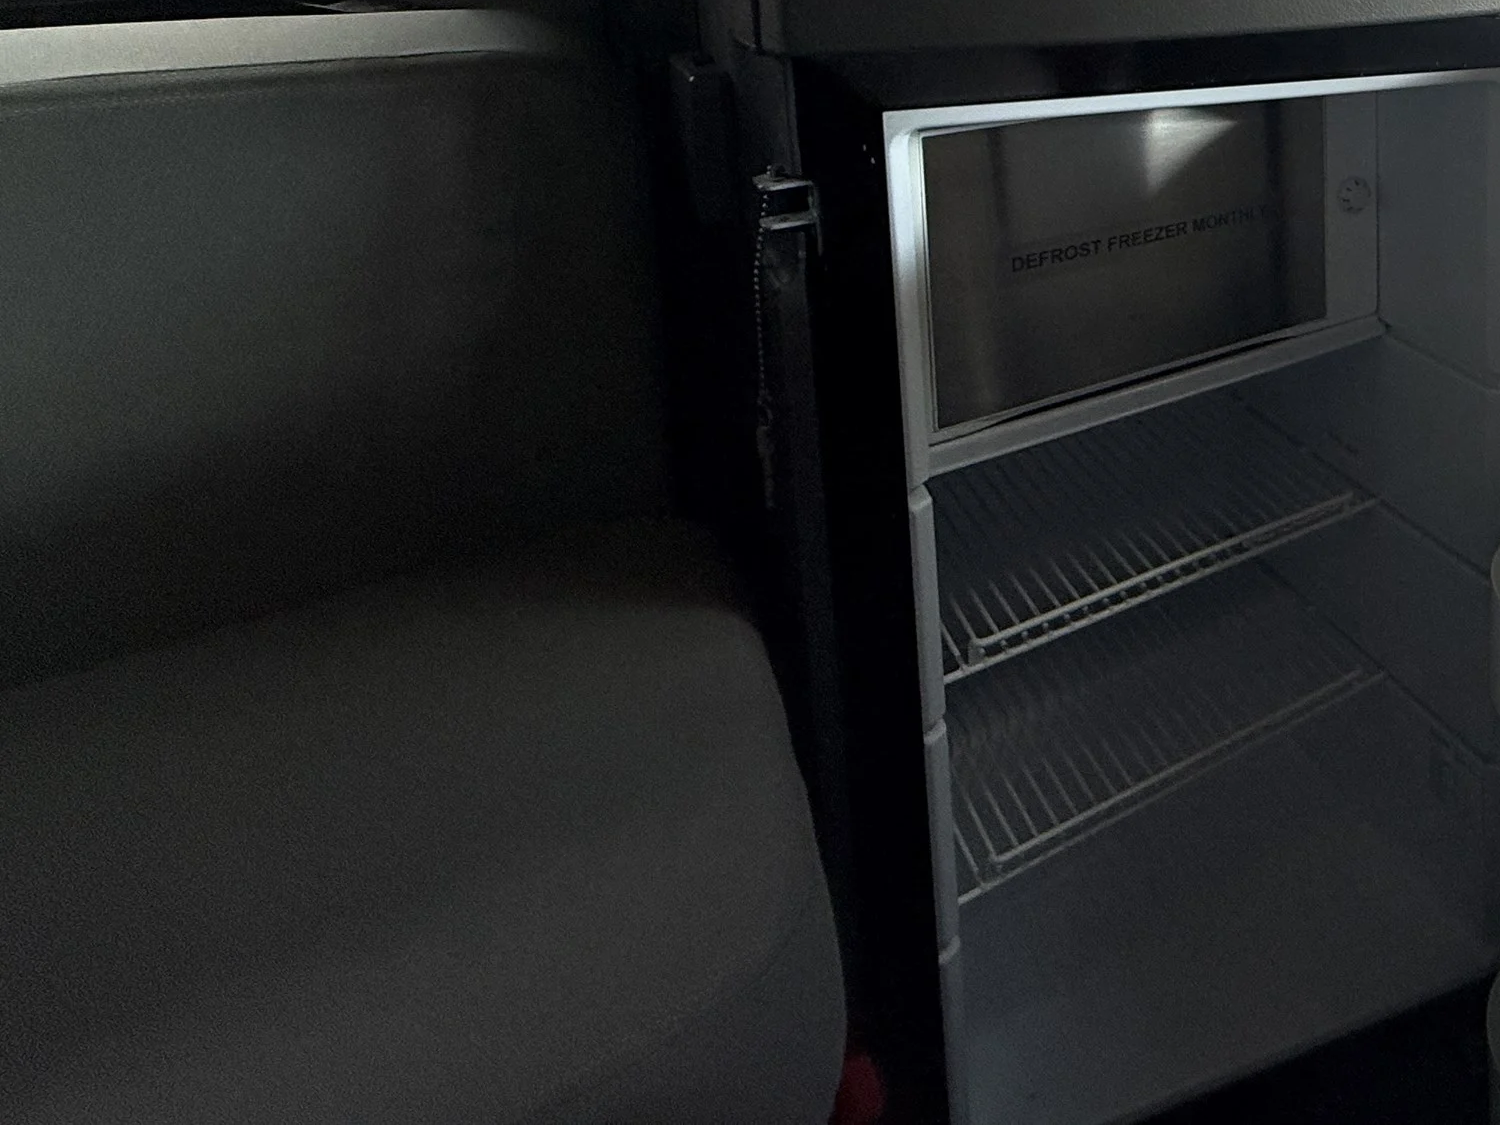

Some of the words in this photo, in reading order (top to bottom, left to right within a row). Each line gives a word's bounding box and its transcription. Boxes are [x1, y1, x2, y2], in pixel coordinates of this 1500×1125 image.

[1011, 239, 1101, 273] DEFROST
[1107, 221, 1188, 252] FREEZER
[1191, 204, 1267, 232] MONTHLY
